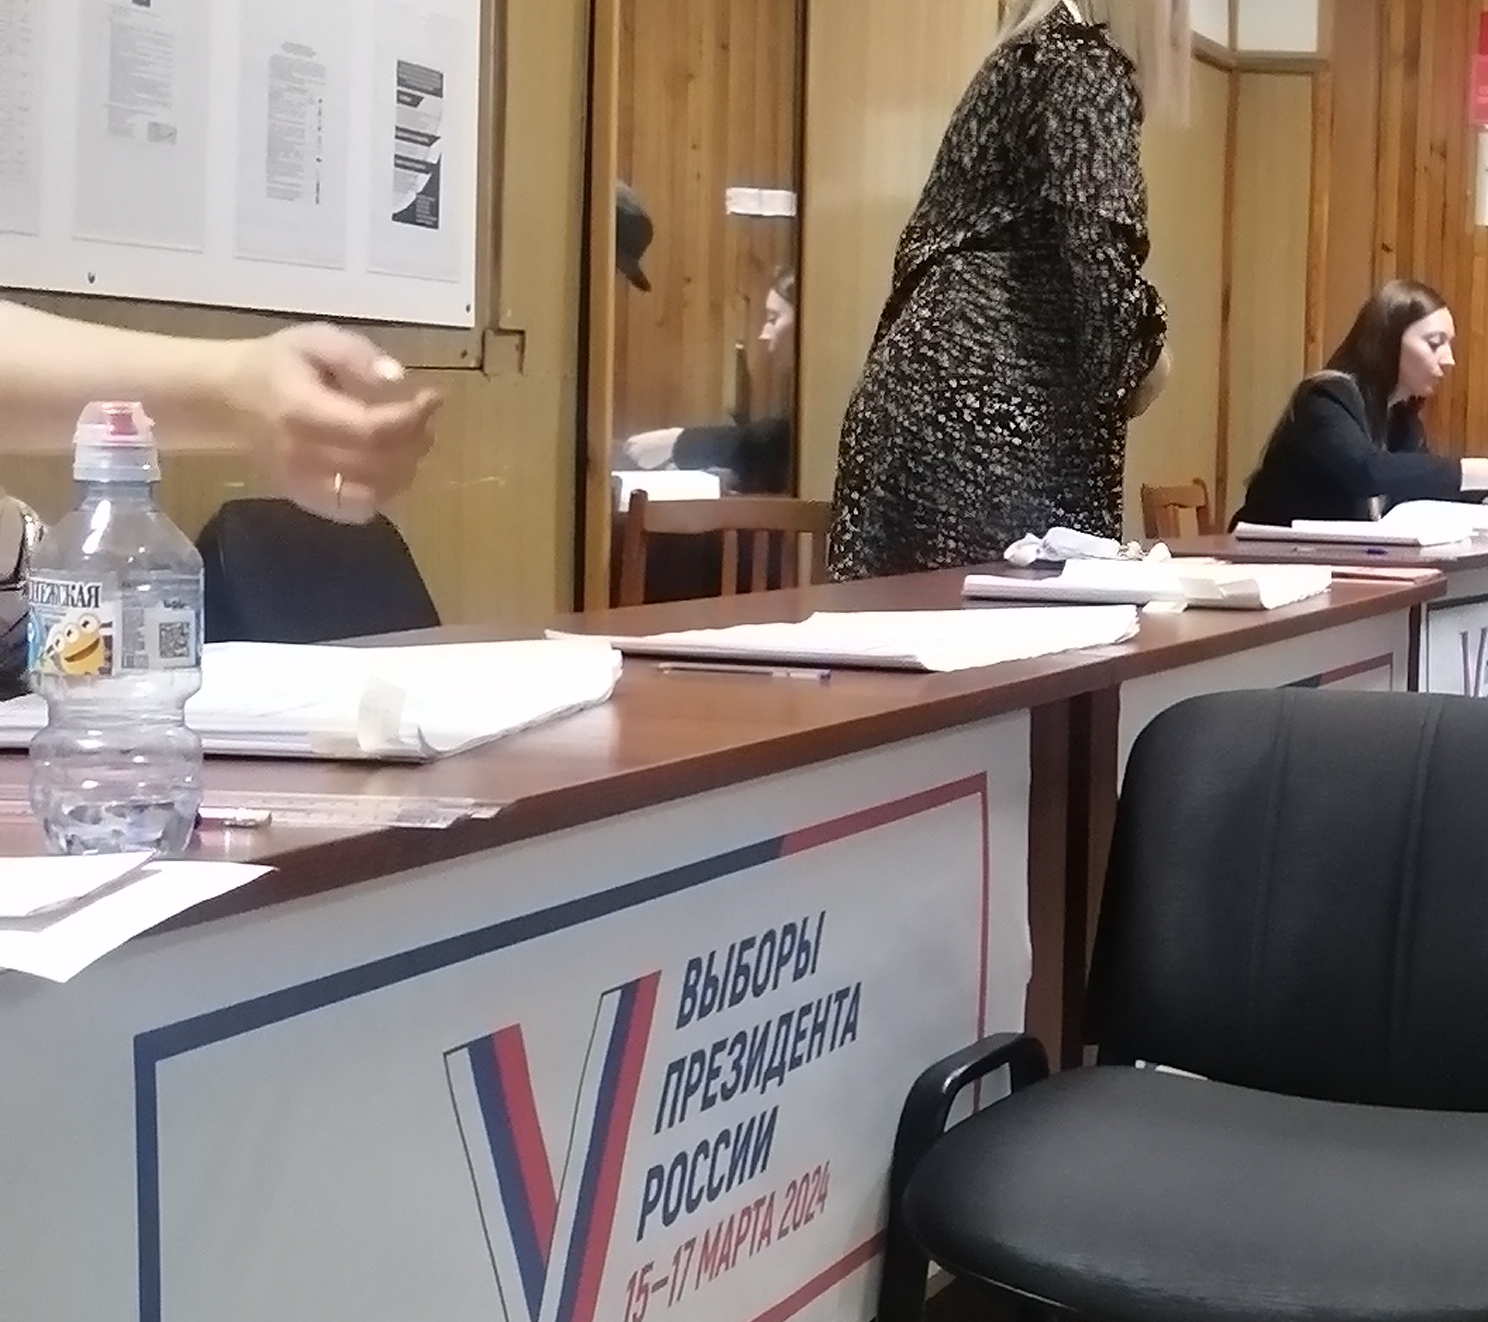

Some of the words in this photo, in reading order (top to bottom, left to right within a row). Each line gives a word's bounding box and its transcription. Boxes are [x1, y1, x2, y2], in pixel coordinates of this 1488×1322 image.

[676, 910, 827, 1030] ВЫБОРЫ
[654, 981, 863, 1135] ПРЕЗИДЕНТА
[636, 1105, 779, 1242] РОССИИ
[695, 1191, 777, 1290] МАРТА
[777, 1159, 831, 1241] 2024
